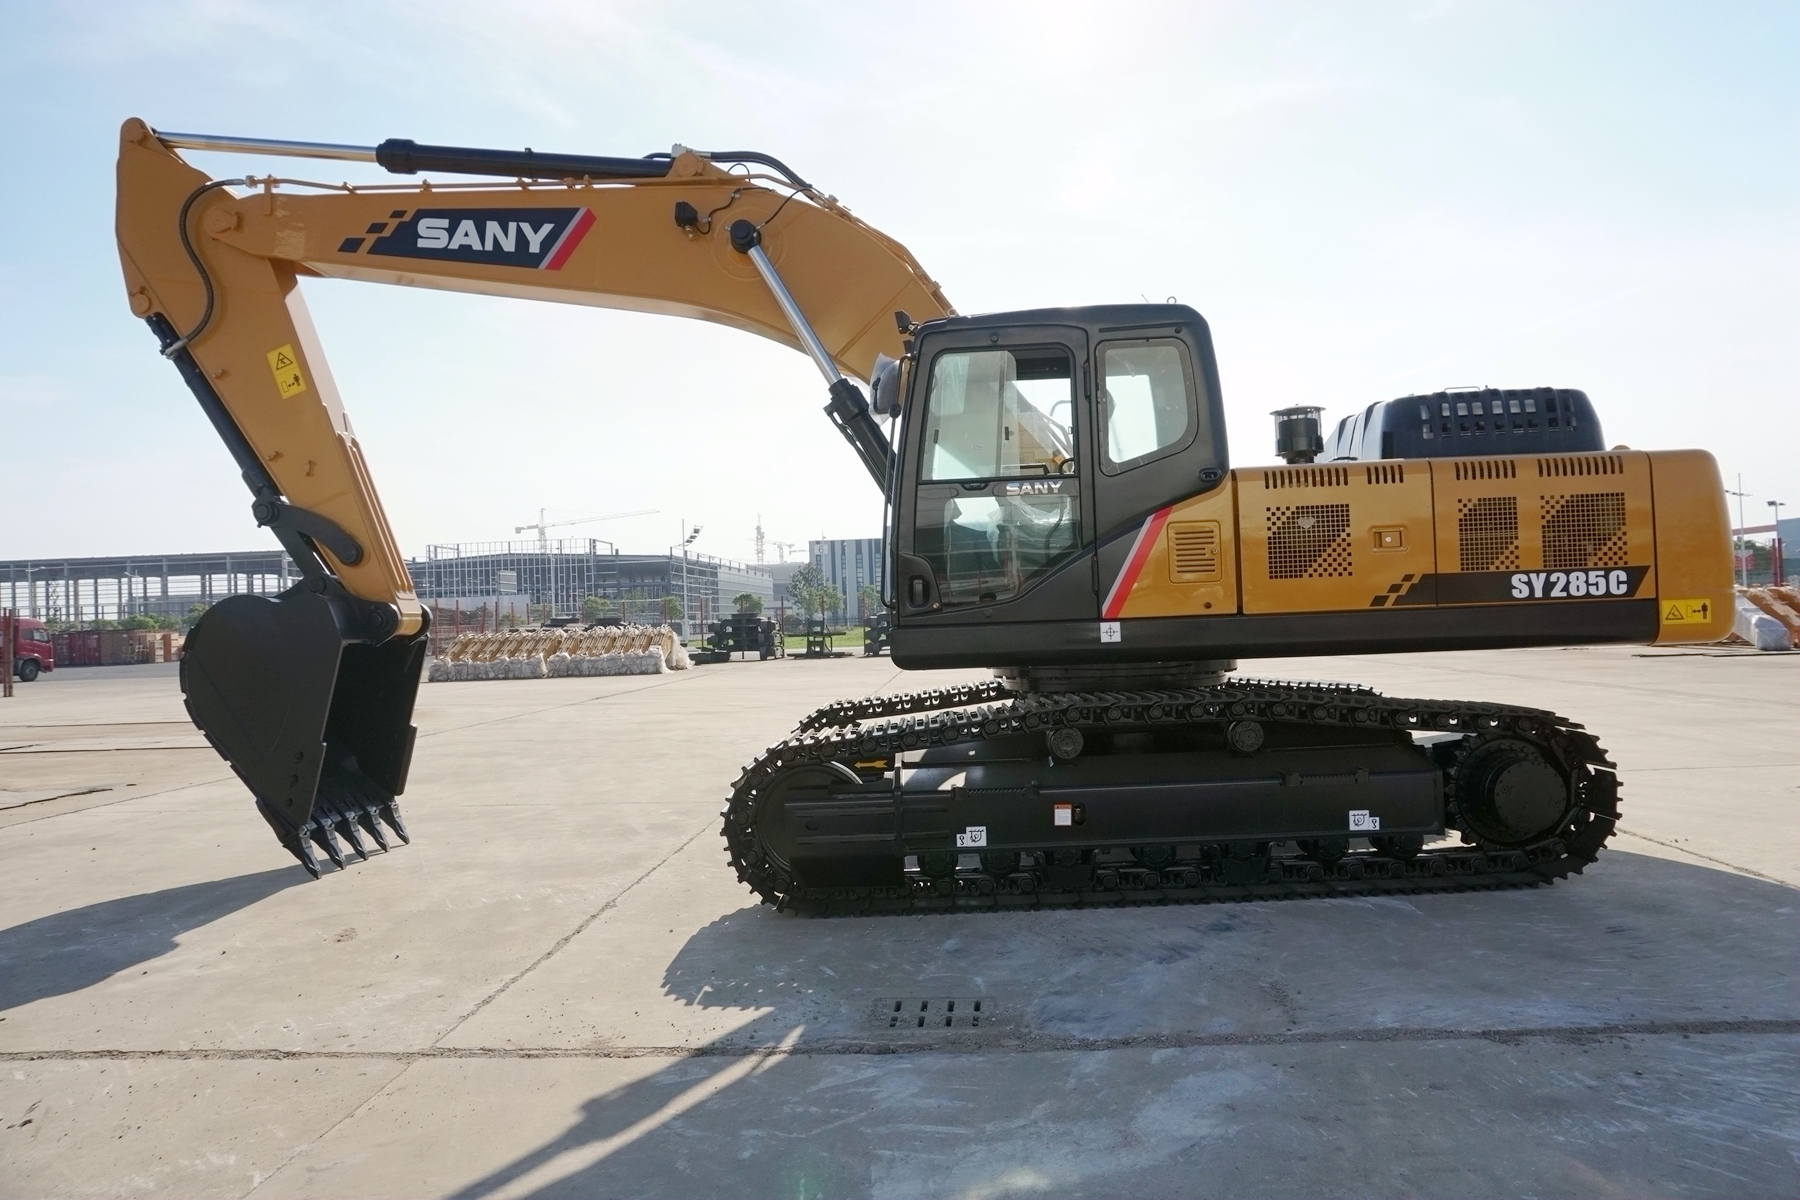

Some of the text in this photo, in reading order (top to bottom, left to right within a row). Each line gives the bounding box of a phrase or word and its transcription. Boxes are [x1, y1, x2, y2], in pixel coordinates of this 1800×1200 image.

[417, 218, 555, 253] SANY
[1006, 480, 1063, 496] SANY
[818, 545, 824, 554] 6
[1511, 570, 1628, 599] SY285C
